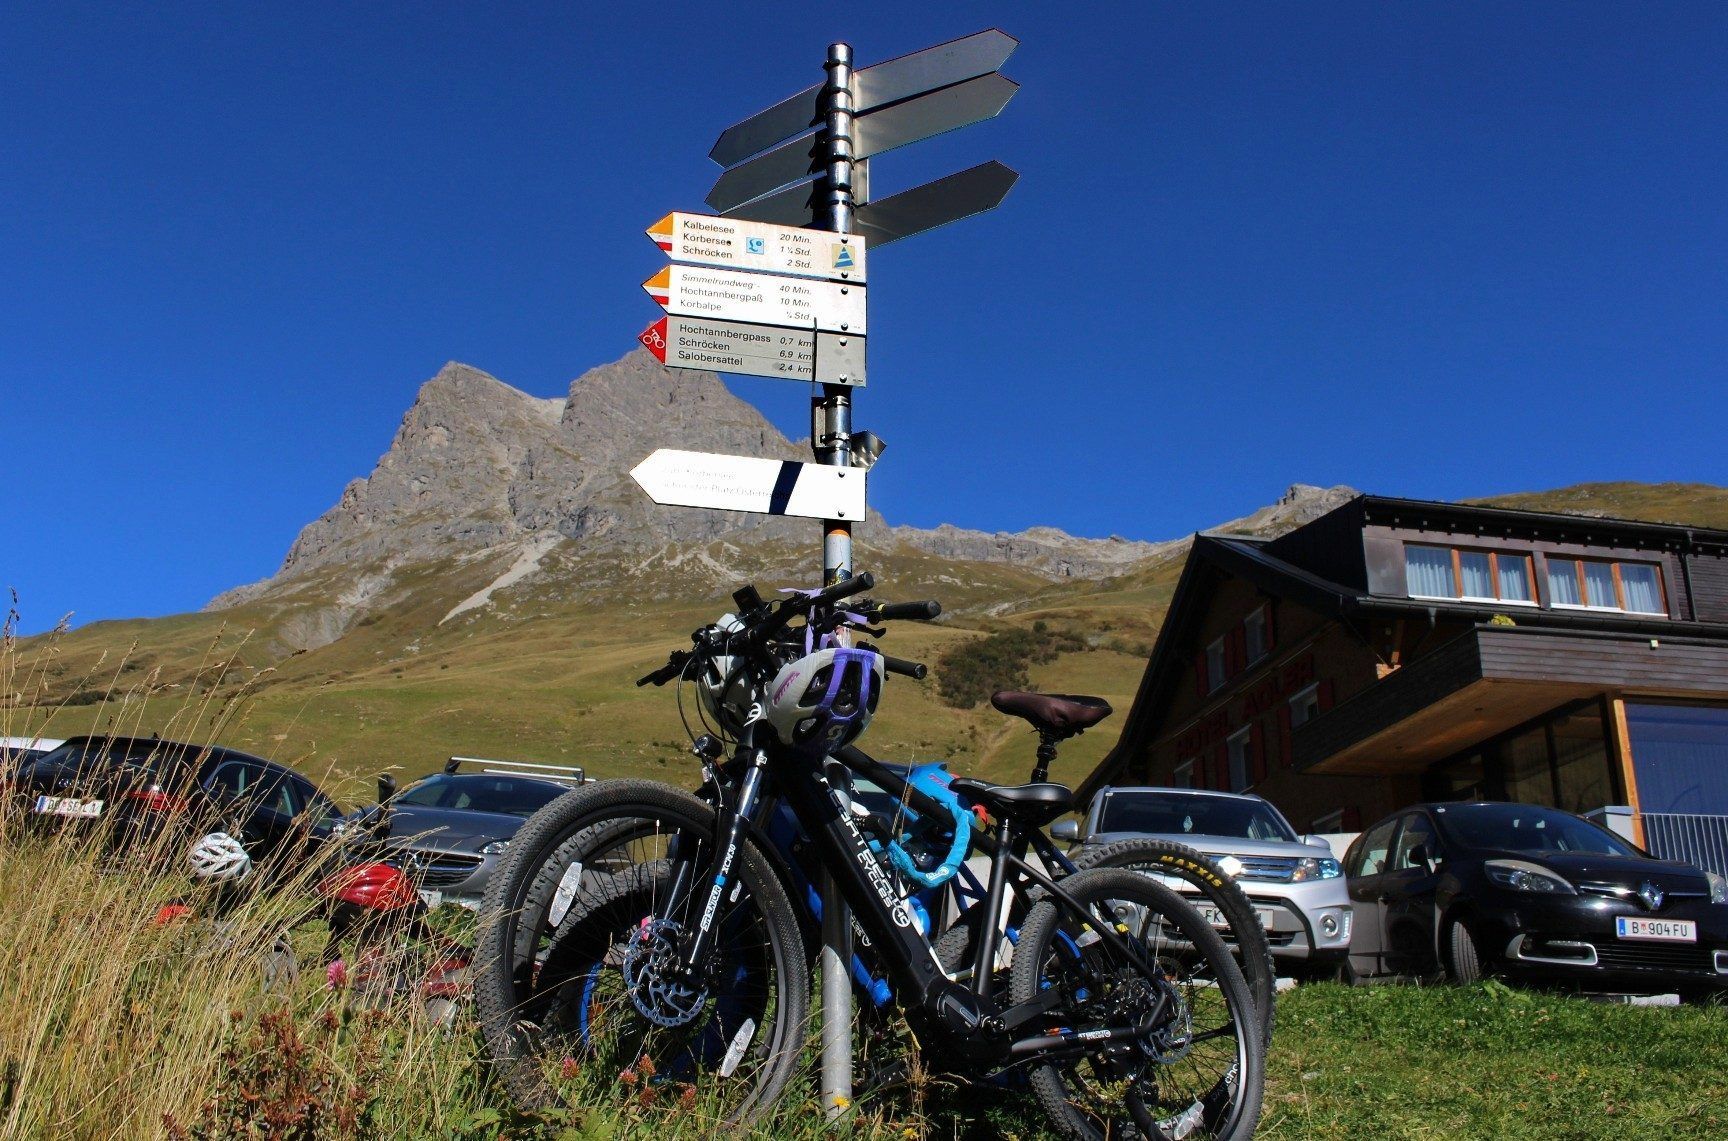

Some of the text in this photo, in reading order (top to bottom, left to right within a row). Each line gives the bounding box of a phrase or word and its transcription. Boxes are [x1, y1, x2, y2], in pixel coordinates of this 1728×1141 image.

[683, 220, 735, 234] Kalbelesee
[779, 233, 812, 244] 20 Min.
[682, 245, 733, 259] Schröcken
[794, 247, 812, 256] Std.
[787, 259, 812, 269] 2 Std.
[779, 285, 812, 295] 40 Min.
[780, 297, 812, 308] 10 Min.
[794, 311, 812, 320] Std.
[679, 323, 771, 342] Hochtannbergpass
[679, 337, 730, 351] Schröcken
[779, 337, 812, 348] 0,7 km
[678, 350, 743, 366] Salobersattel
[779, 349, 812, 360] 6,9 km
[779, 363, 812, 374] 2,4 km
[1160, 855, 1222, 887] MAXXIS
[1632, 921, 1688, 937] B 904 FU
